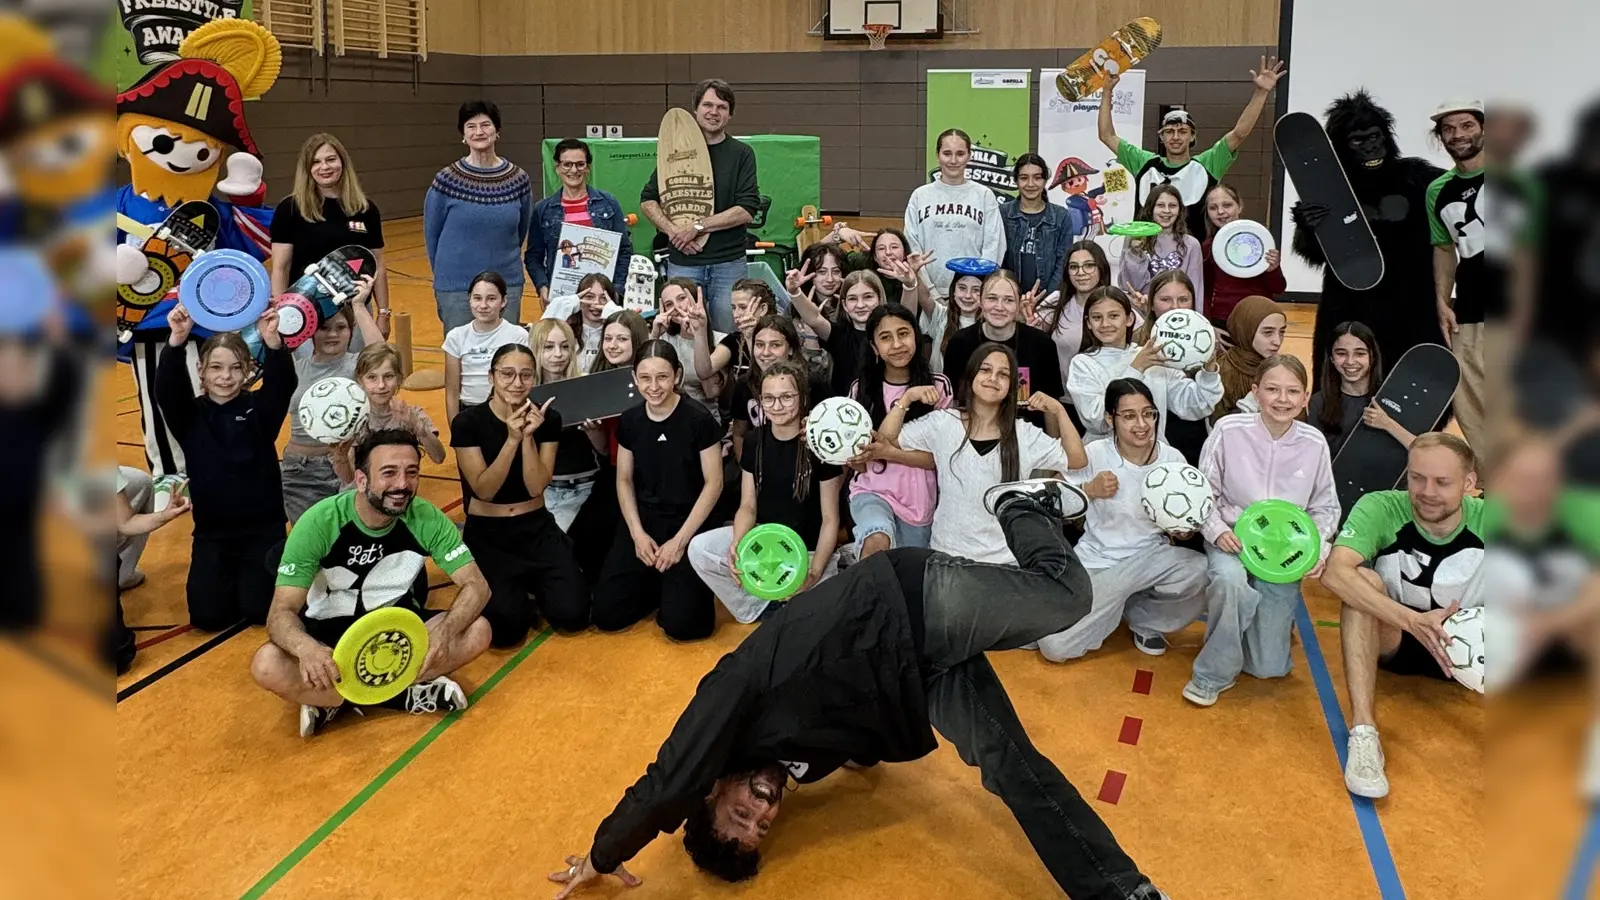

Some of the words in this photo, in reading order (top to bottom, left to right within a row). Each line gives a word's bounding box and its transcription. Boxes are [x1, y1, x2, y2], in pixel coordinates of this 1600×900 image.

[932, 167, 1018, 188] FESTYLE
[660, 188, 713, 202] FREESTYLE
[669, 203, 706, 214] AWARDS
[918, 205, 931, 224] LE
[935, 203, 984, 226] MARAIS
[1159, 330, 1191, 341] GORILLA
[347, 543, 384, 566] Let's
